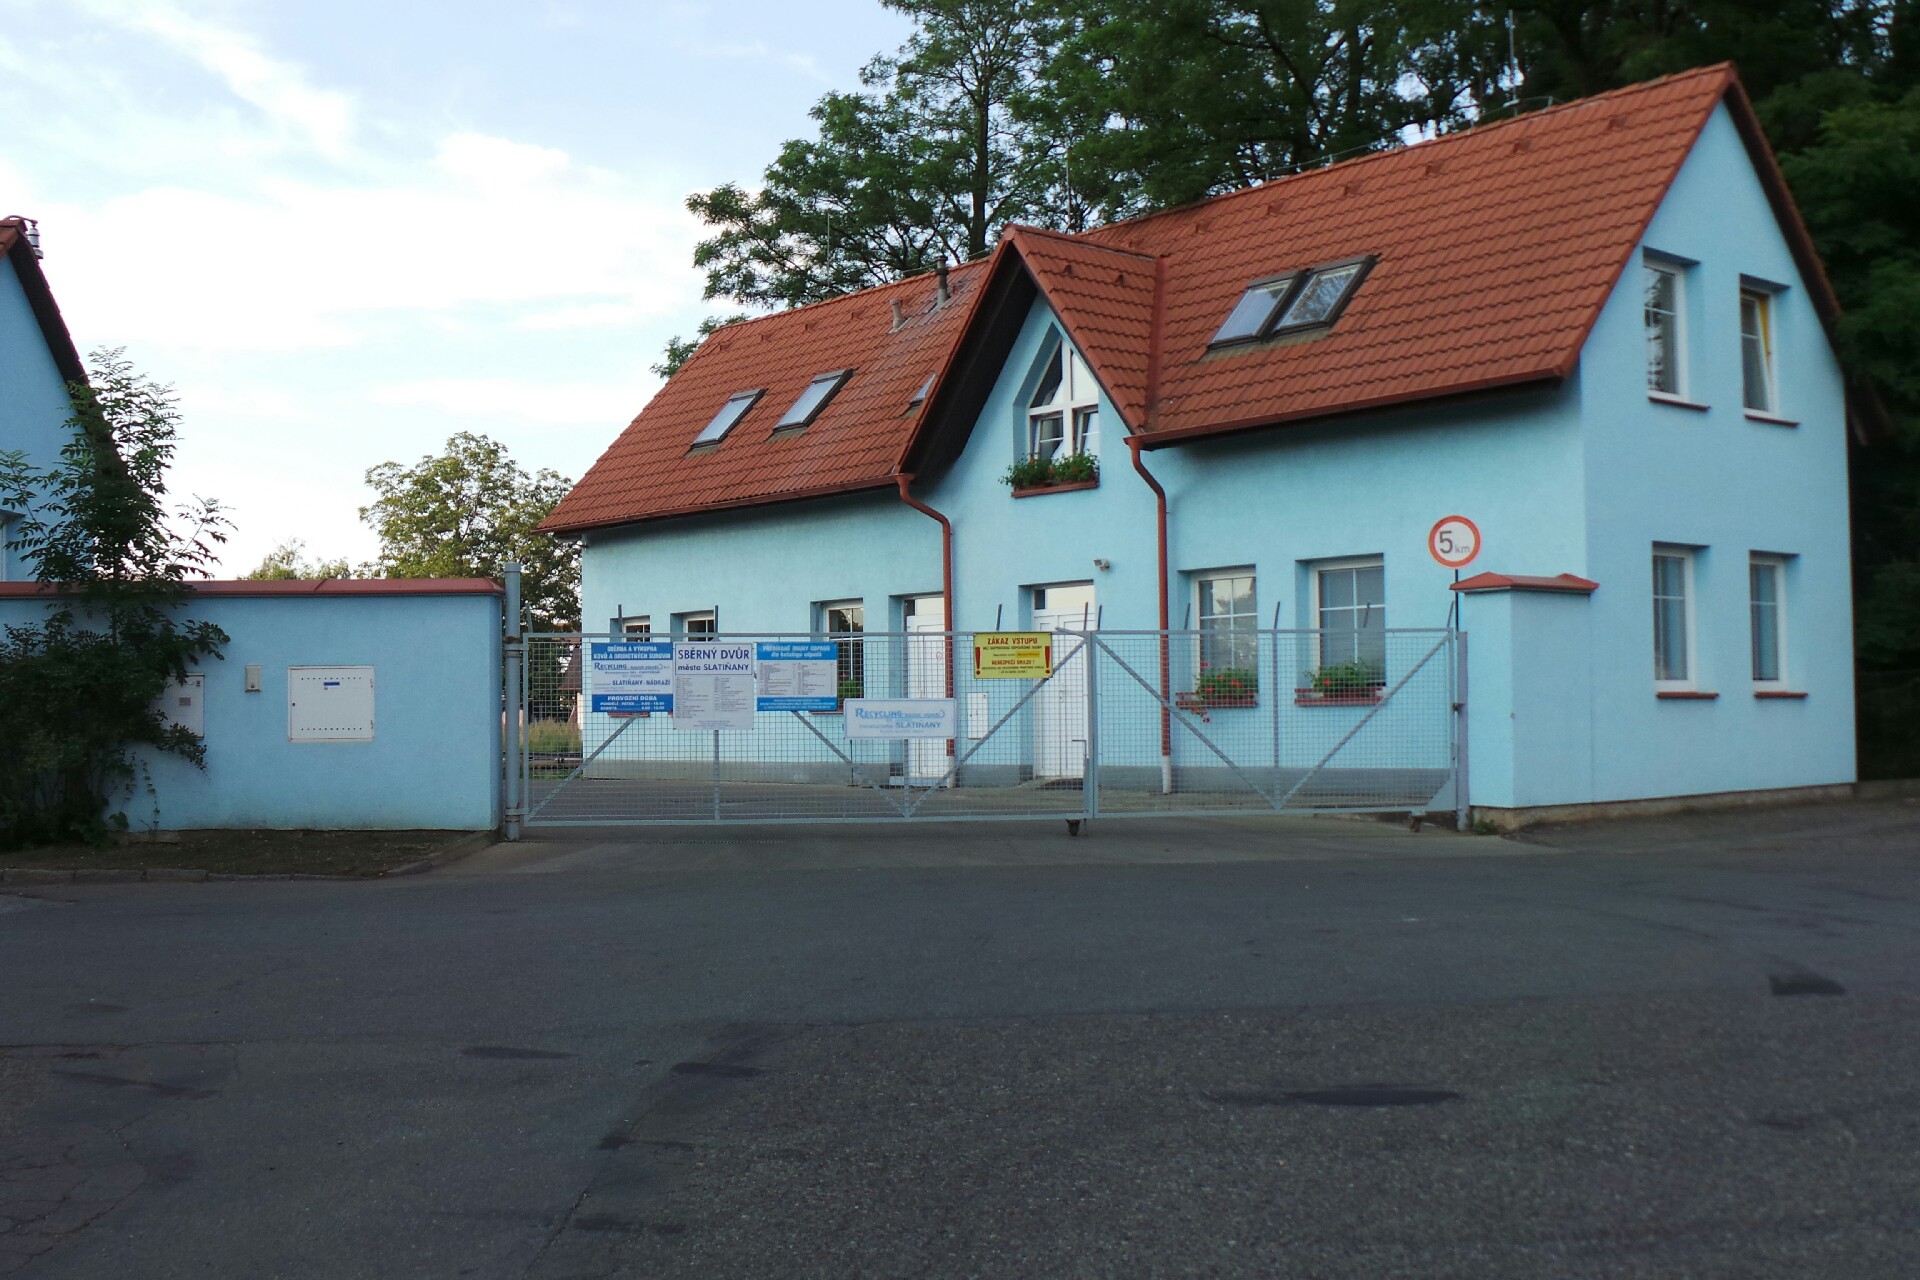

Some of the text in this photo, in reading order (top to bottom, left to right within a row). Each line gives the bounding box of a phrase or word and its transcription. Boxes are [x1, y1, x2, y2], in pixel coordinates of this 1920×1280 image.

[1439, 530, 1470, 554] 5 km
[988, 636, 1008, 644] ZÁKAZ
[678, 647, 718, 659] SBĚRNÝ
[720, 647, 750, 659] DVŮR
[704, 662, 750, 671] SLATIŇANY
